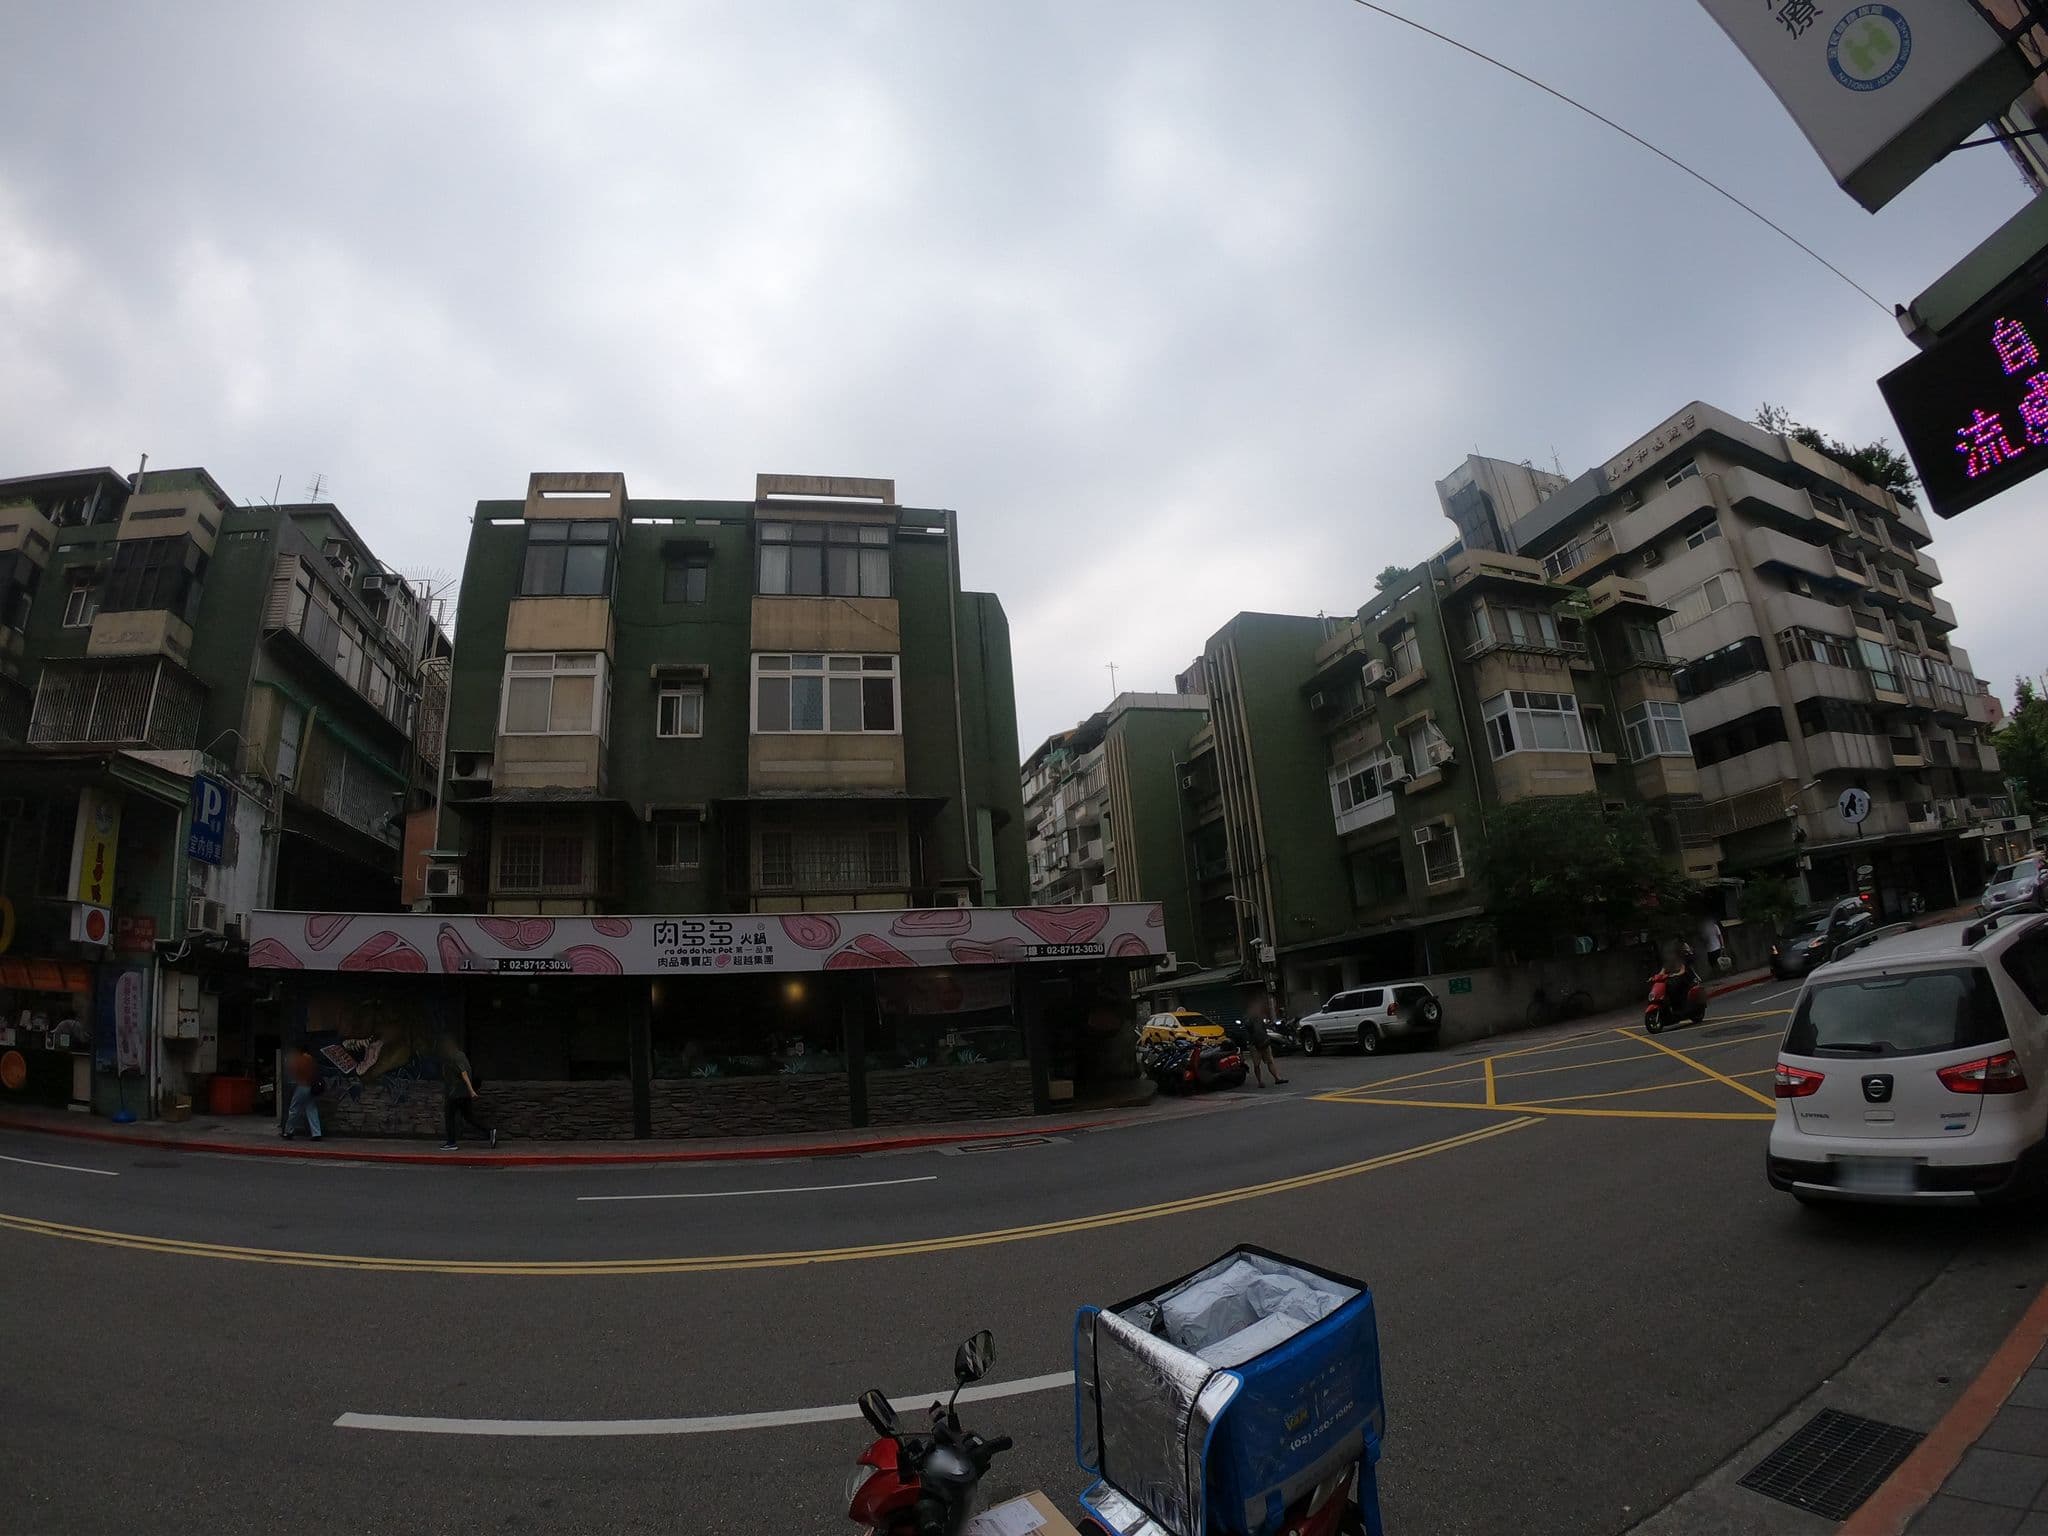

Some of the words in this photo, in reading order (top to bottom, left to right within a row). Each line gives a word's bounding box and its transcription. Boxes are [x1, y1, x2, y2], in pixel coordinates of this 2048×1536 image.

[1767, 0, 1823, 40] 療
[1992, 316, 2040, 375] 自
[200, 781, 222, 824] P
[653, 920, 733, 947] 肉多多
[740, 932, 767, 946] 火鍋
